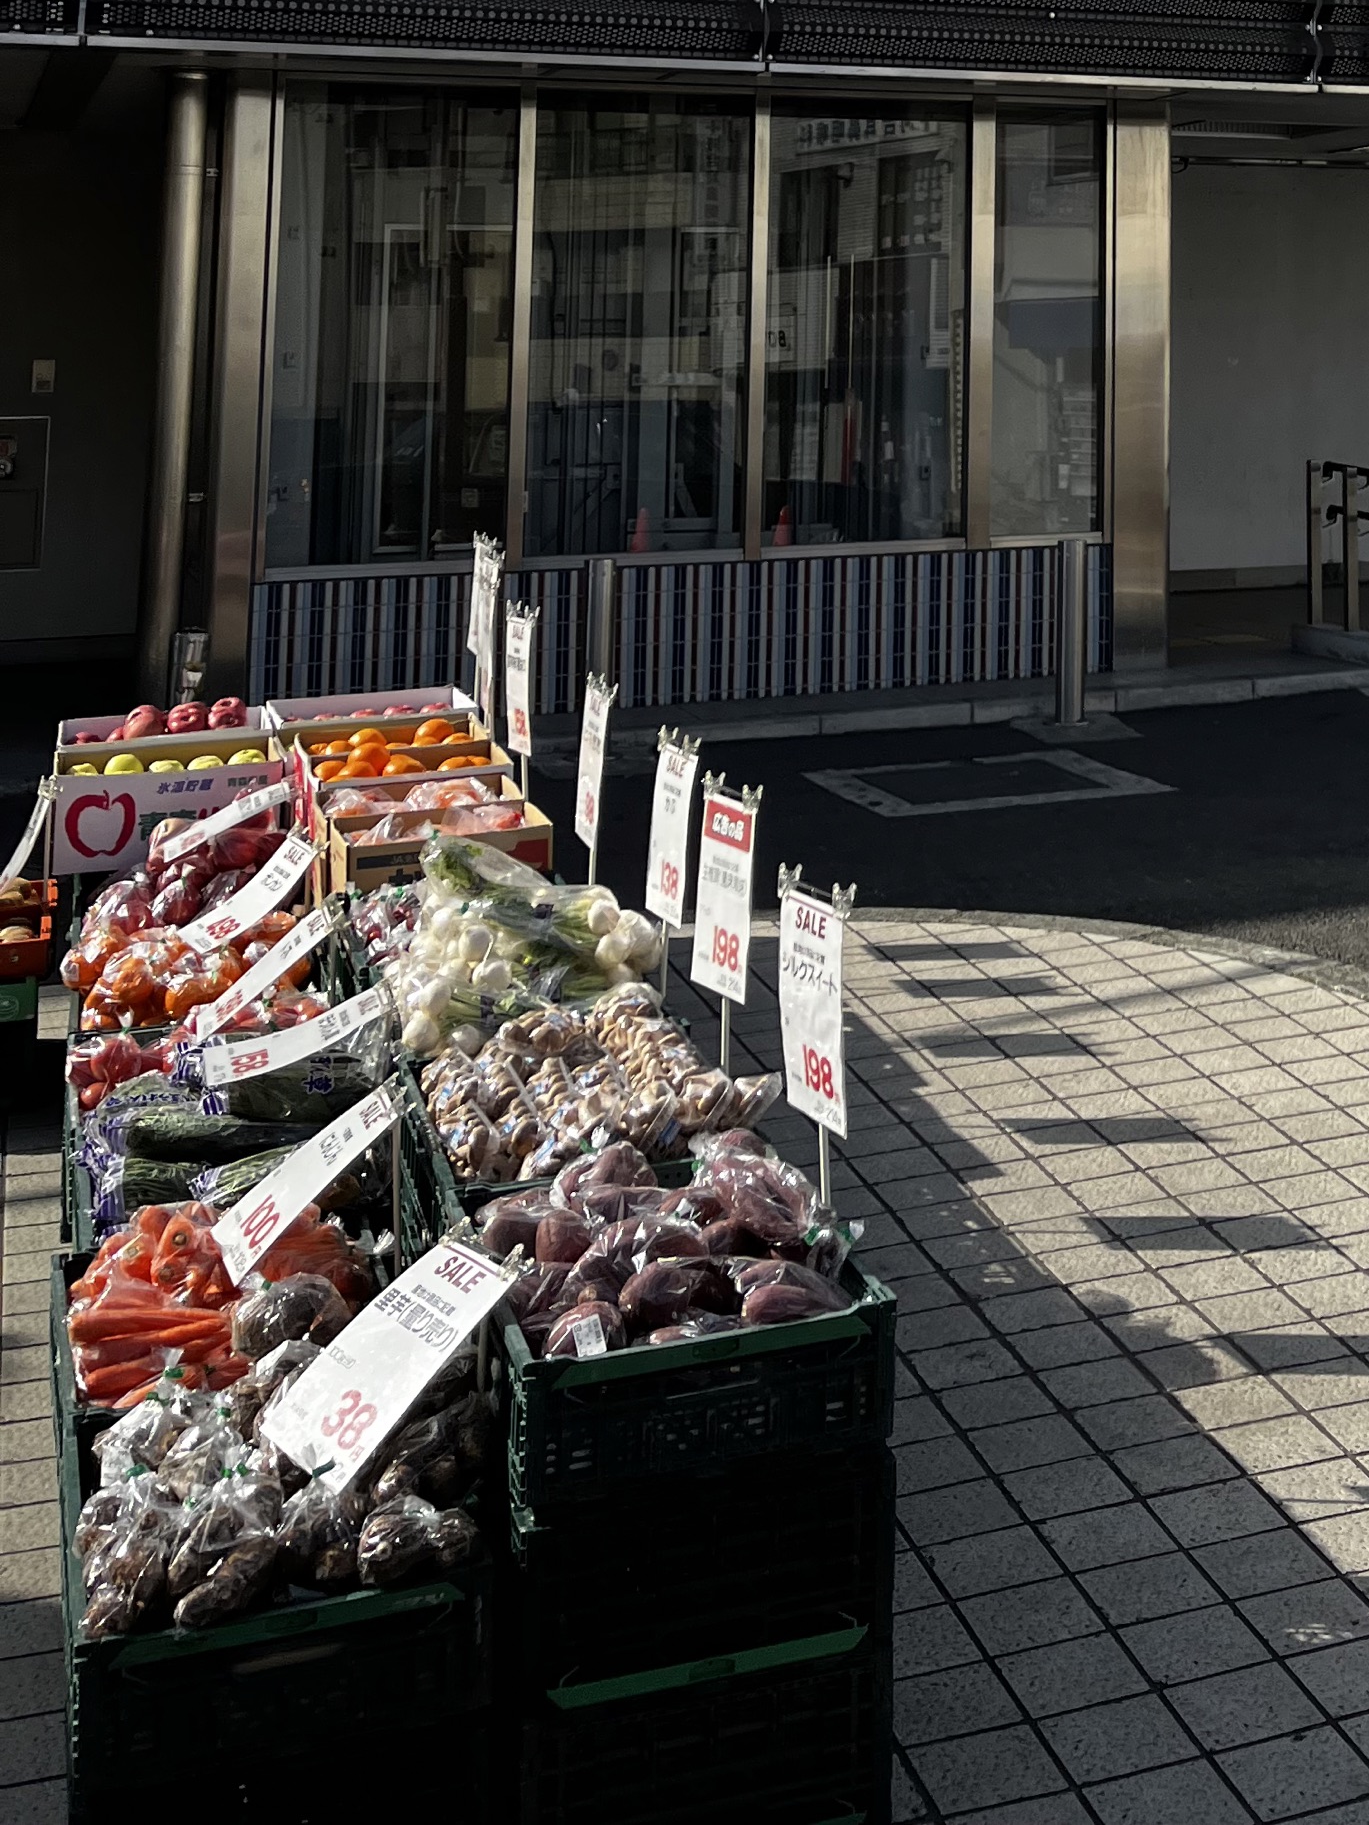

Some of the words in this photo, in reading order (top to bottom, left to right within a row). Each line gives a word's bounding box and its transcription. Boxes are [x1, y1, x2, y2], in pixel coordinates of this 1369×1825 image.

[660, 859, 679, 901] 138
[794, 906, 827, 940] SALE
[712, 925, 740, 972] 198
[782, 950, 839, 997] シルクスイート
[230, 1048, 270, 1075] 158
[802, 1043, 834, 1100] 198
[433, 1255, 488, 1295] SALE
